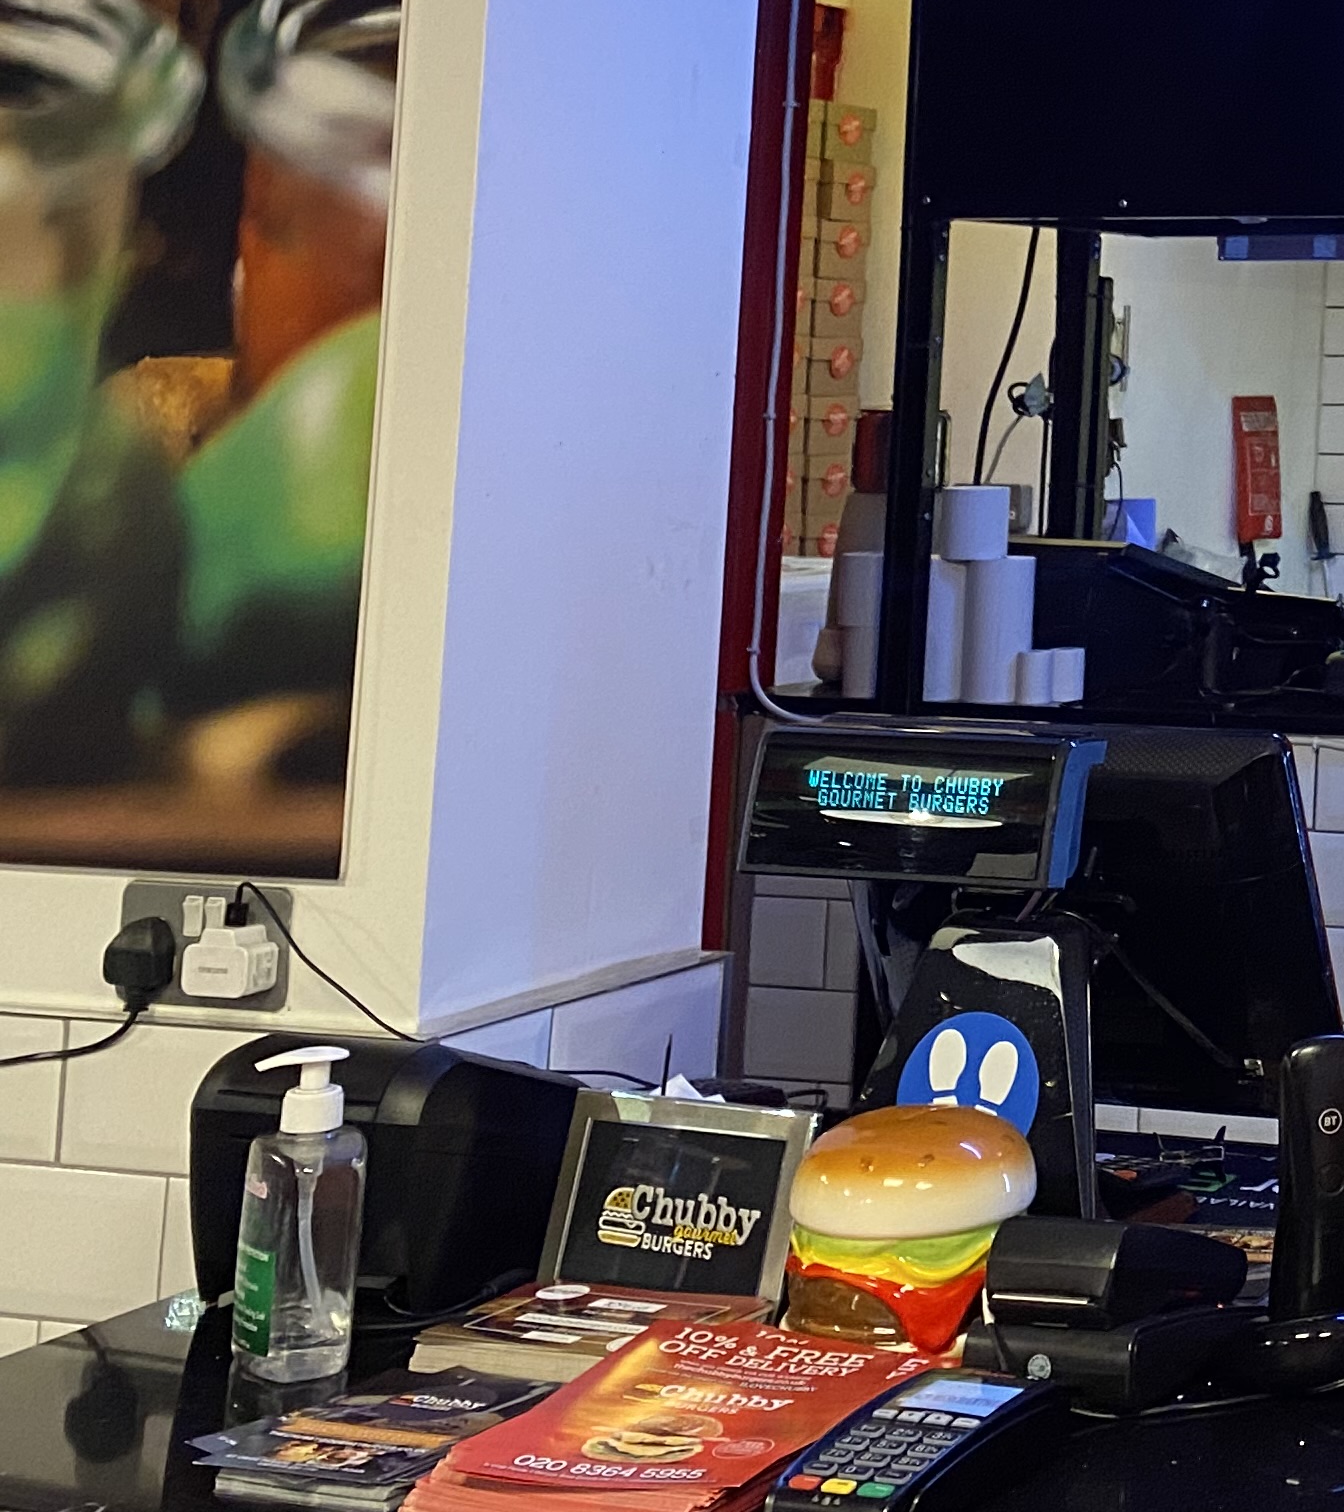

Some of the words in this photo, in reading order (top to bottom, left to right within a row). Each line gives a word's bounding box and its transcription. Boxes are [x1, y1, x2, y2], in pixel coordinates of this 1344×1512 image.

[808, 769, 889, 791] WELCOME
[901, 774, 923, 793] TO
[934, 776, 1004, 797] CHUBBY
[817, 789, 898, 810] GOURMET
[909, 793, 990, 815] BURGERS
[1324, 1115, 1338, 1127] BT
[631, 1184, 762, 1246] Chubby
[639, 1233, 714, 1260] BURGERS
[672, 1224, 738, 1246] gourmet
[658, 1339, 728, 1361] OFF
[724, 1355, 860, 1377] DELIVERY
[675, 1327, 740, 1350] 10%
[739, 1345, 758, 1356] &
[762, 1345, 875, 1368] FREE
[659, 1384, 795, 1411] Chubby
[513, 1454, 569, 1471] 020
[569, 1462, 638, 1478] 8364
[638, 1467, 708, 1480] 5955
